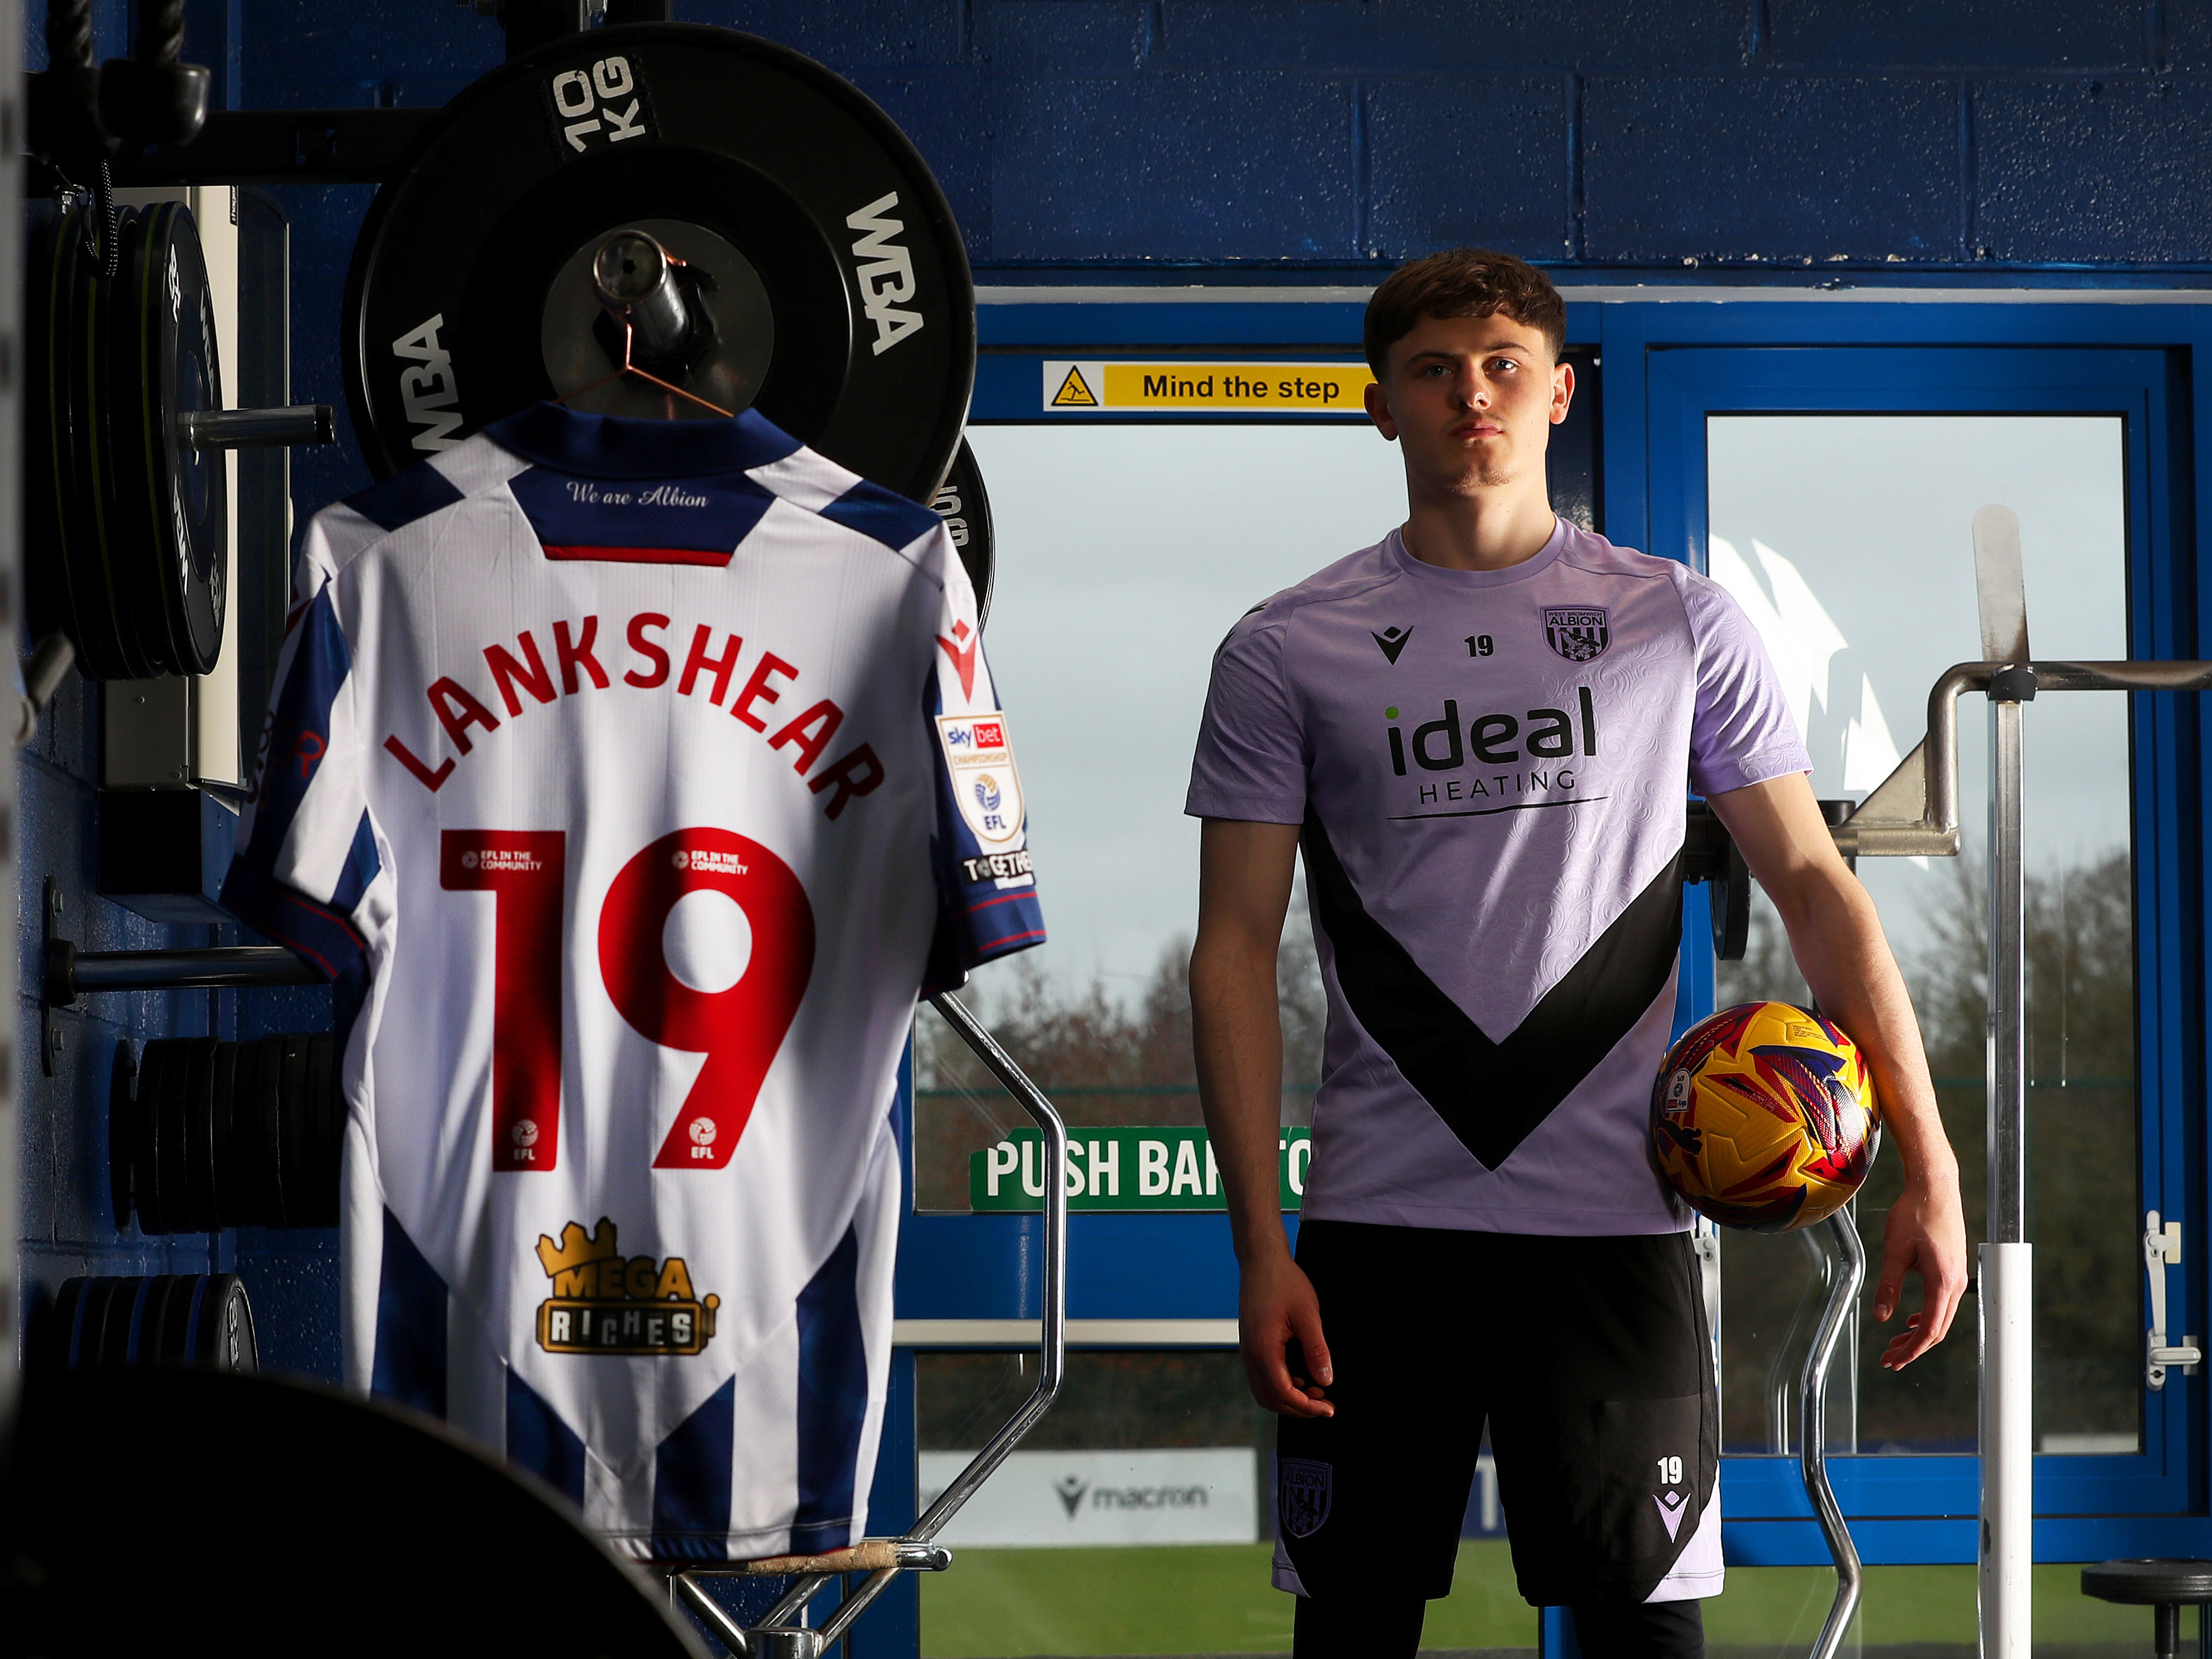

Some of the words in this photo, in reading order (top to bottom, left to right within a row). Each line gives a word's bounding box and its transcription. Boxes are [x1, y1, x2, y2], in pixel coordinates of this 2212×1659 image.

[553, 70, 601, 153] 10
[593, 56, 646, 142] KG
[846, 191, 925, 357] WBA
[392, 313, 463, 451] WBA
[1144, 375, 1213, 397] Mind
[1223, 375, 1268, 397] the
[1278, 377, 1340, 404] step
[566, 481, 601, 503] We
[603, 492, 633, 505] are
[638, 485, 710, 507] Albion
[1549, 616, 1603, 626] ALBION
[1464, 635, 1494, 657] 19
[384, 612, 886, 821] LANKSHEAR
[948, 727, 971, 748] sky
[974, 726, 1001, 743] bet
[1385, 686, 1596, 776] ideal
[1419, 770, 1575, 804] HEATING
[984, 815, 1006, 830] EFL
[481, 850, 498, 861] EFL
[500, 851, 512, 861] IN
[513, 851, 532, 861] THE
[481, 861, 542, 871] COMMUNITY
[691, 860, 748, 875] COMMUNITY
[692, 850, 709, 862] EFL
[709, 851, 721, 862] IN
[721, 852, 739, 865] THE
[439, 827, 816, 1172] 19
[513, 1149, 535, 1161] EFL
[691, 1146, 714, 1159] EFL
[987, 1140, 1119, 1196] PUSH
[554, 1256, 695, 1300] MEGA
[551, 1309, 691, 1346] RICHES
[1285, 1471, 1324, 1488] ALBION
[1657, 1456, 1683, 1485] 19
[1093, 1484, 1208, 1508] macron
